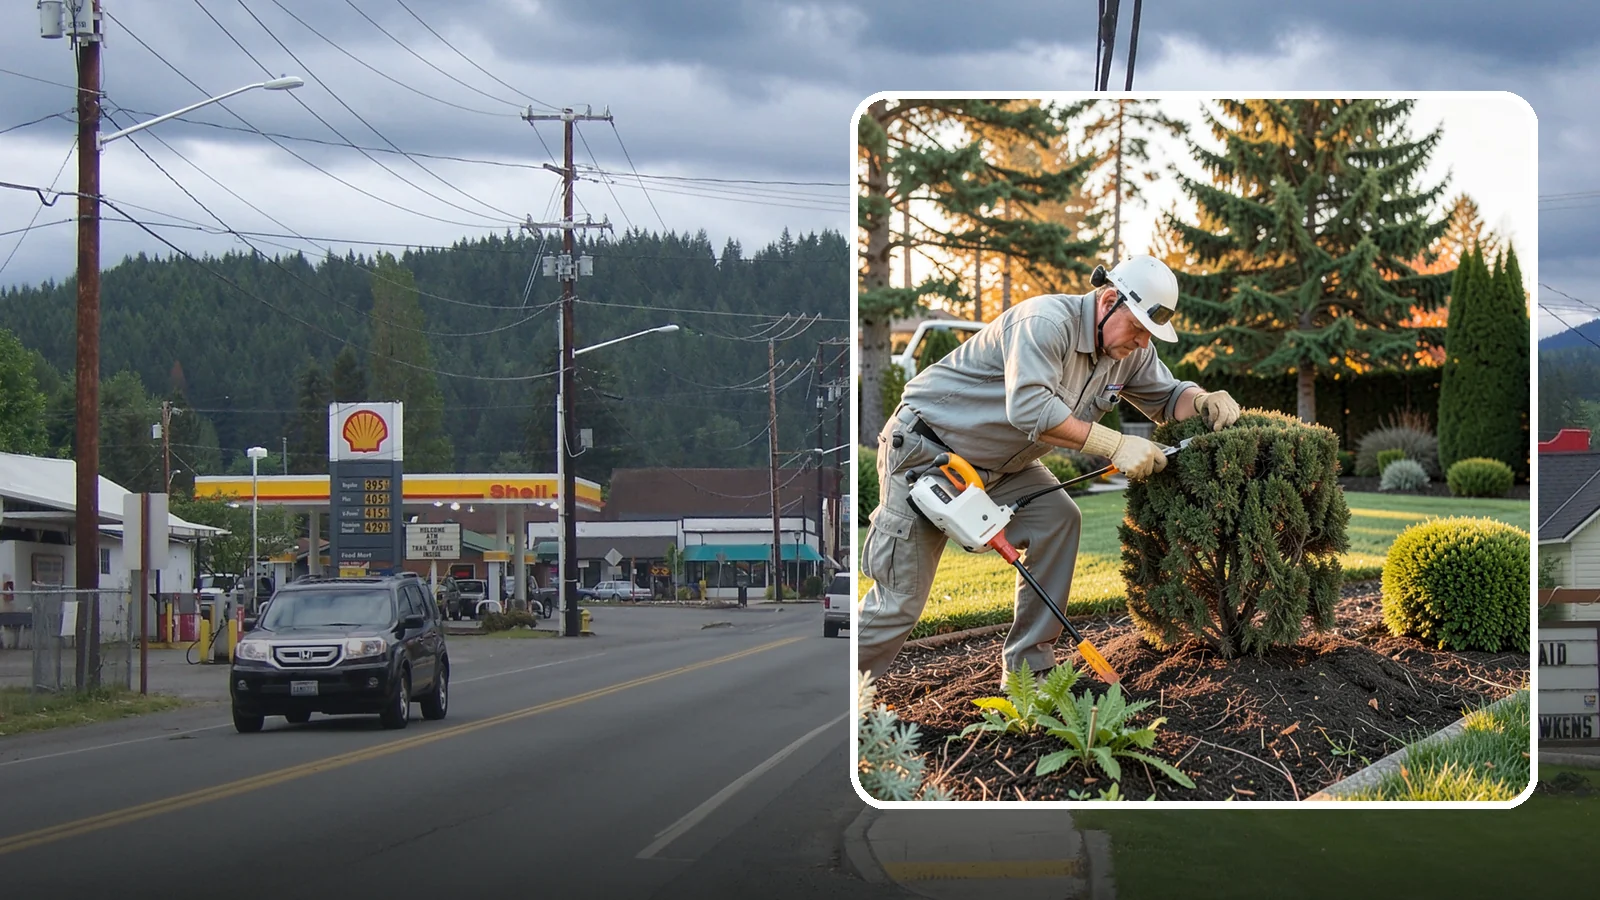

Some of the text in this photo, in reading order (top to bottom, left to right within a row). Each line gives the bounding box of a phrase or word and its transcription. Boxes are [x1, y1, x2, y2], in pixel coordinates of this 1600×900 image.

[366, 480, 383, 490] 395
[490, 484, 547, 499] Shell
[366, 494, 383, 504] 405
[366, 508, 383, 518] 415
[366, 522, 383, 532] 429
